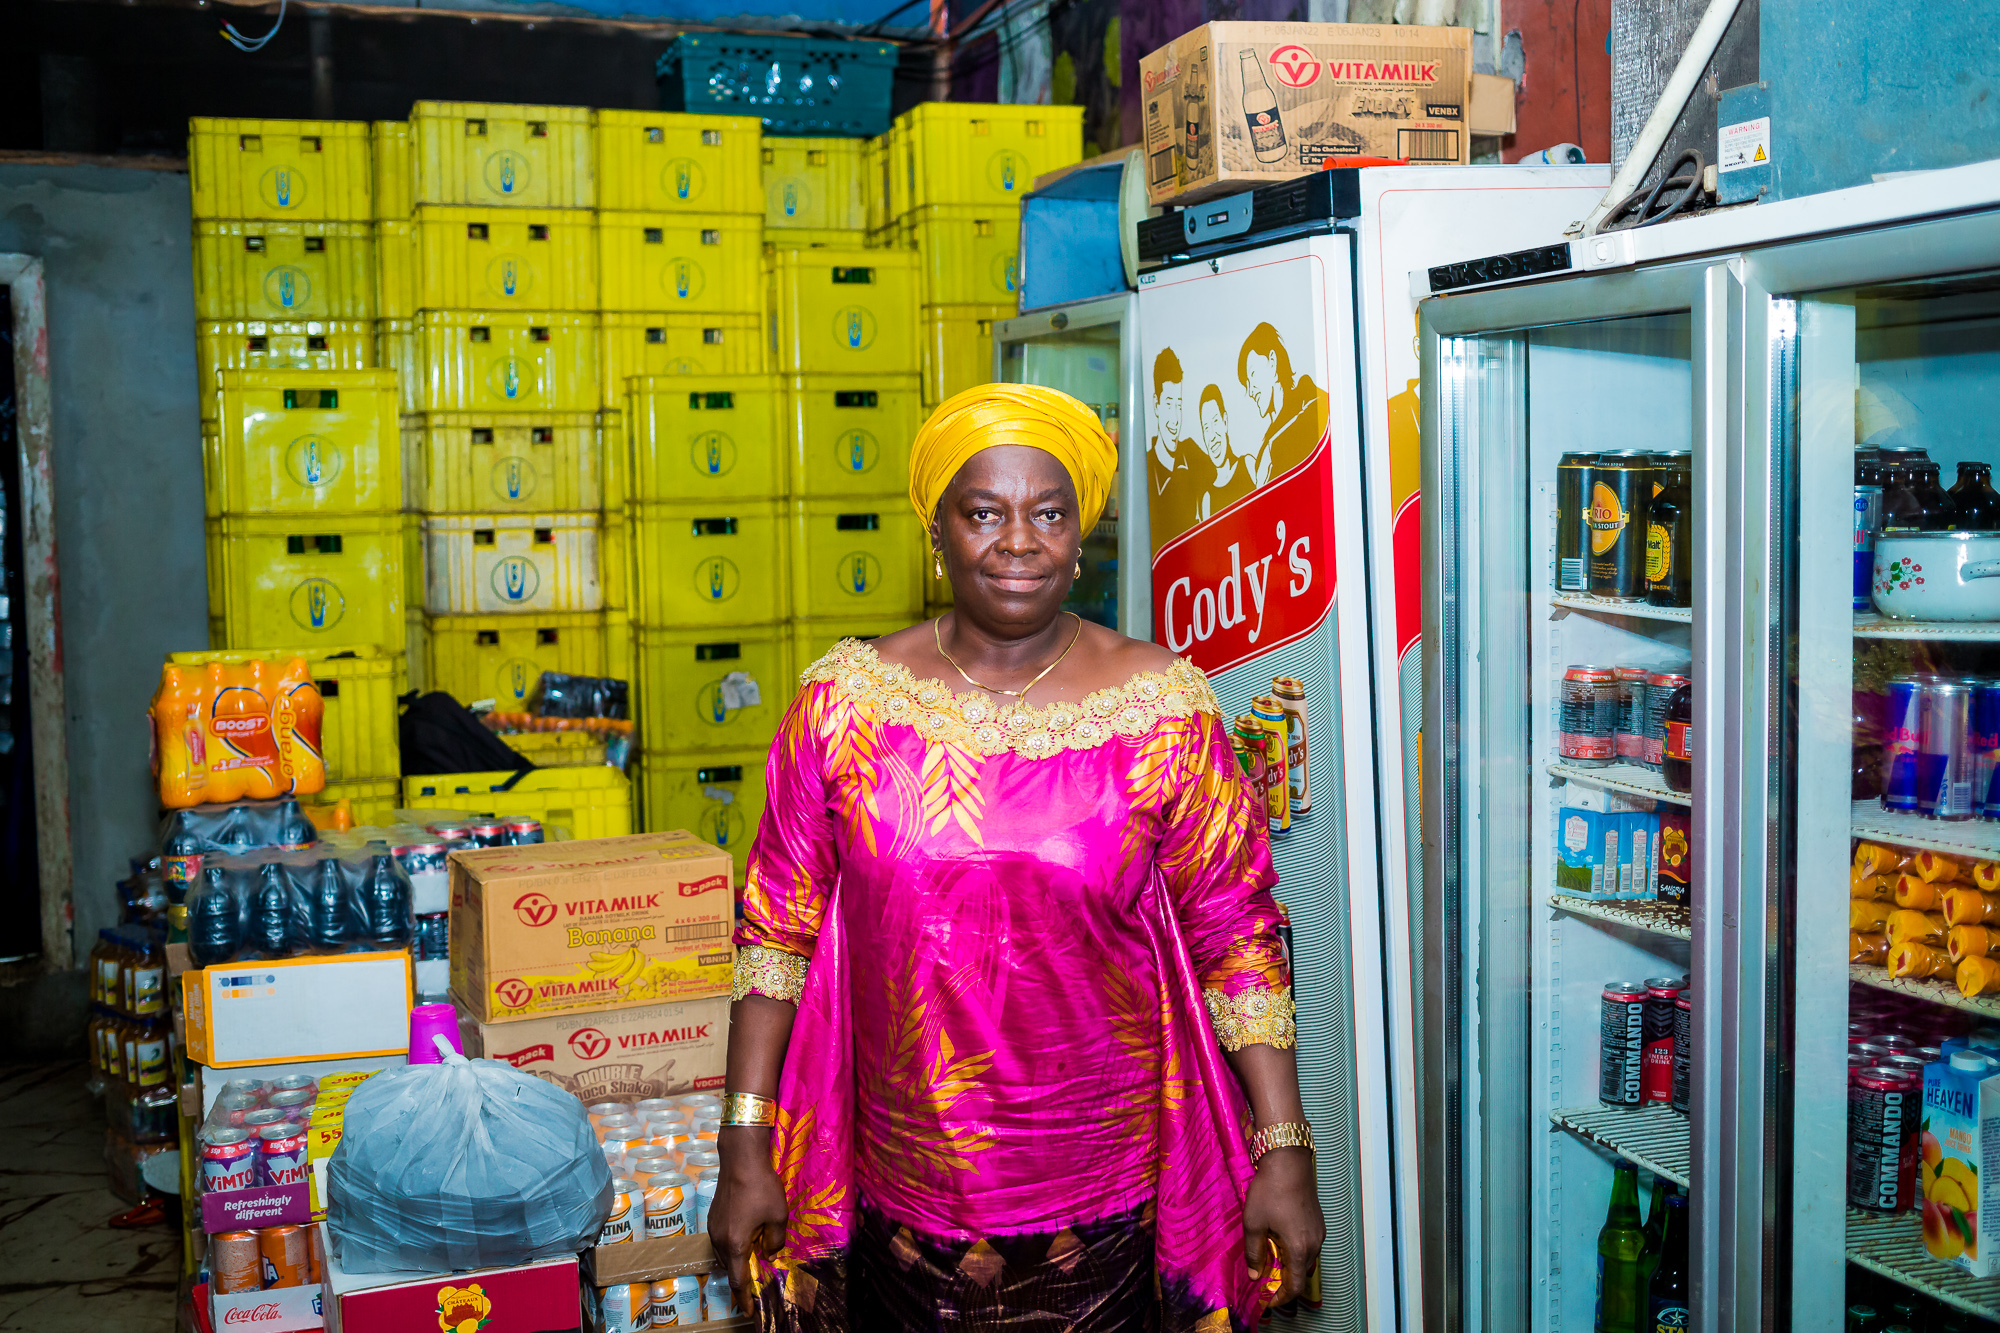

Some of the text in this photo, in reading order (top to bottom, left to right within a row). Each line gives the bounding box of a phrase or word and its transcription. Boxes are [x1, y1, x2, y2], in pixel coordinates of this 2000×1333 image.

[1328, 62, 1436, 82] VITAMILK
[1352, 96, 1414, 117] ENERGY
[1428, 106, 1458, 116] VENBX
[1594, 508, 1612, 520] RIO
[1598, 522, 1619, 530] STOUT
[1164, 519, 1314, 653] Cody's
[216, 718, 266, 730] BOOST
[280, 697, 294, 776] orange
[1288, 747, 1304, 767] dy's
[1268, 766, 1284, 785] dy's
[1270, 794, 1278, 802] ALT
[682, 878, 723, 896] 6-pack
[564, 895, 660, 916] VITAMILK
[566, 924, 656, 948] Banana
[539, 976, 620, 998] VITAMILK
[618, 1024, 710, 1048] VITAMILK
[503, 1048, 546, 1066] -pack
[1624, 1003, 1643, 1103] COMMANDO
[577, 1066, 642, 1088] DOUBLE
[575, 1080, 650, 1102] hoco Shake
[1927, 1087, 1973, 1119] HEAVEN
[1949, 1127, 1972, 1145] MANGO
[1879, 1092, 1903, 1208] COMMANDO
[205, 1166, 254, 1191] ViMTO
[270, 1162, 308, 1186] ViMT
[224, 1195, 292, 1211] Refreshingly
[235, 1207, 283, 1220] different
[604, 1220, 631, 1236] LTINA
[447, 1296, 478, 1306] CHÂTEAUX
[224, 1302, 282, 1325] Coca-Cola
